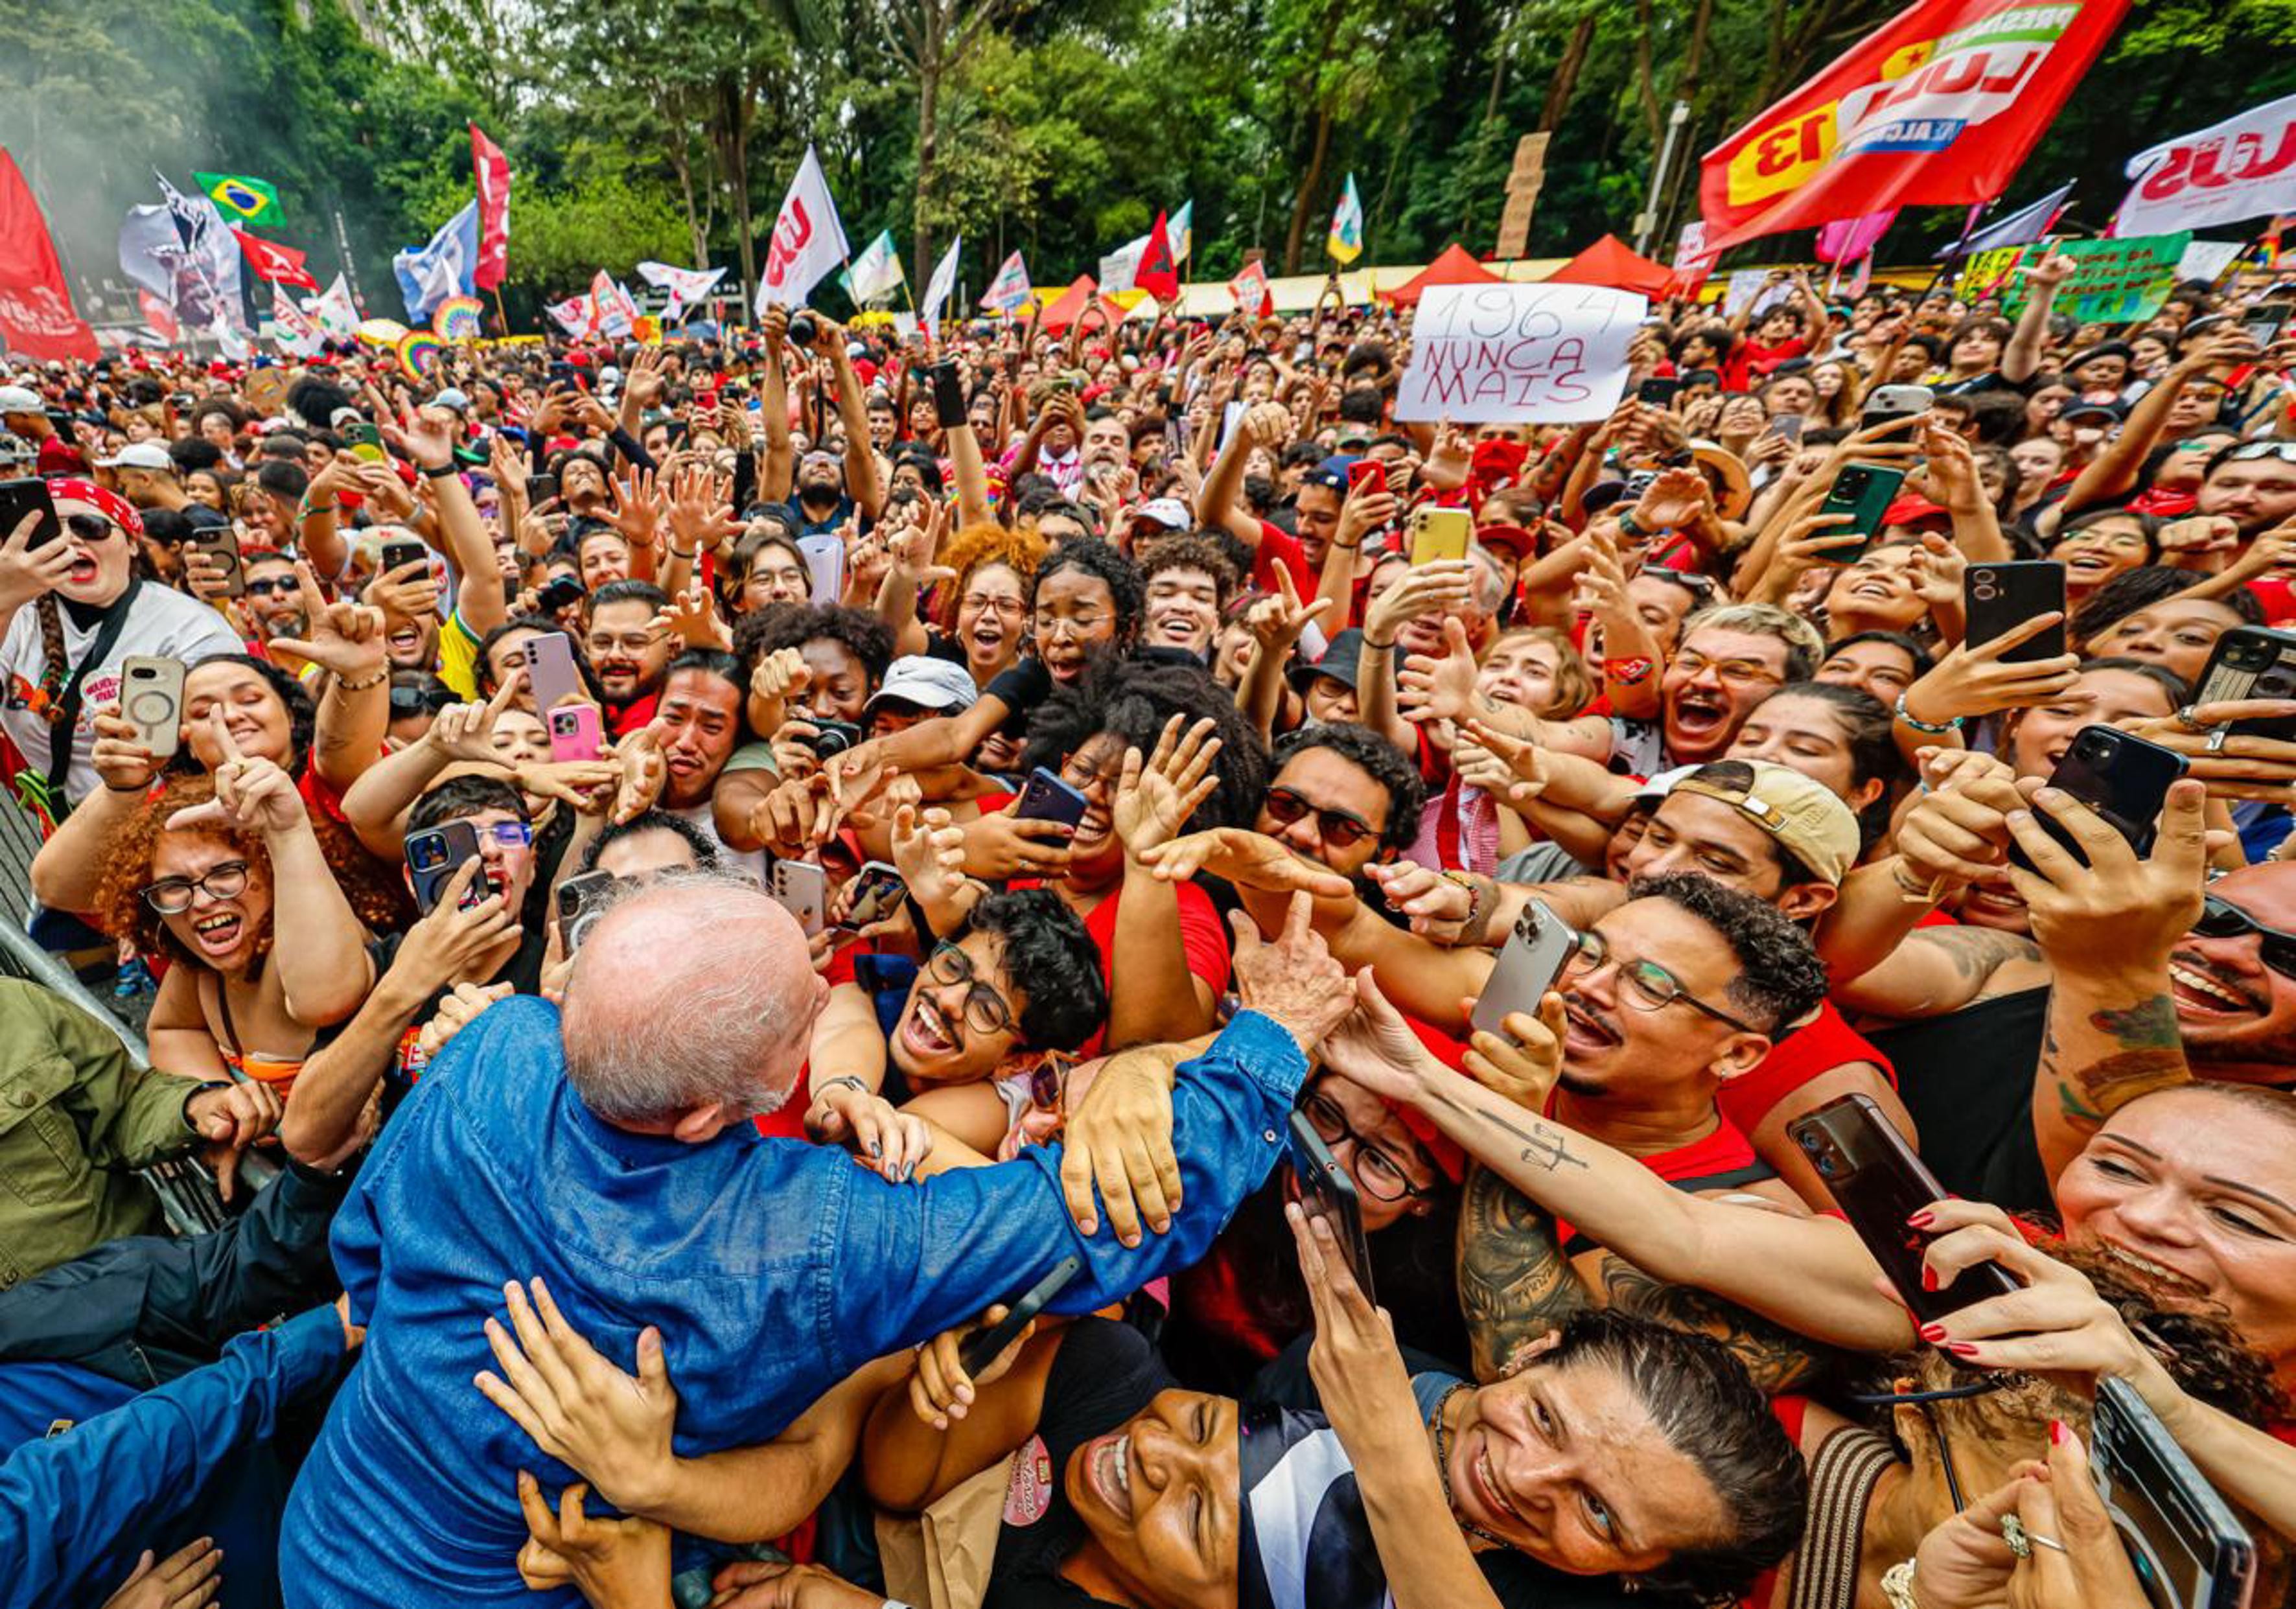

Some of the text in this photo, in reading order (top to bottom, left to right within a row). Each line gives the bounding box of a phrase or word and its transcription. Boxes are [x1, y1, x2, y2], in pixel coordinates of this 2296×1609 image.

[1427, 288, 1620, 340] 1964
[1424, 337, 1585, 373] NUNCA
[1421, 369, 1592, 407] MAIS
